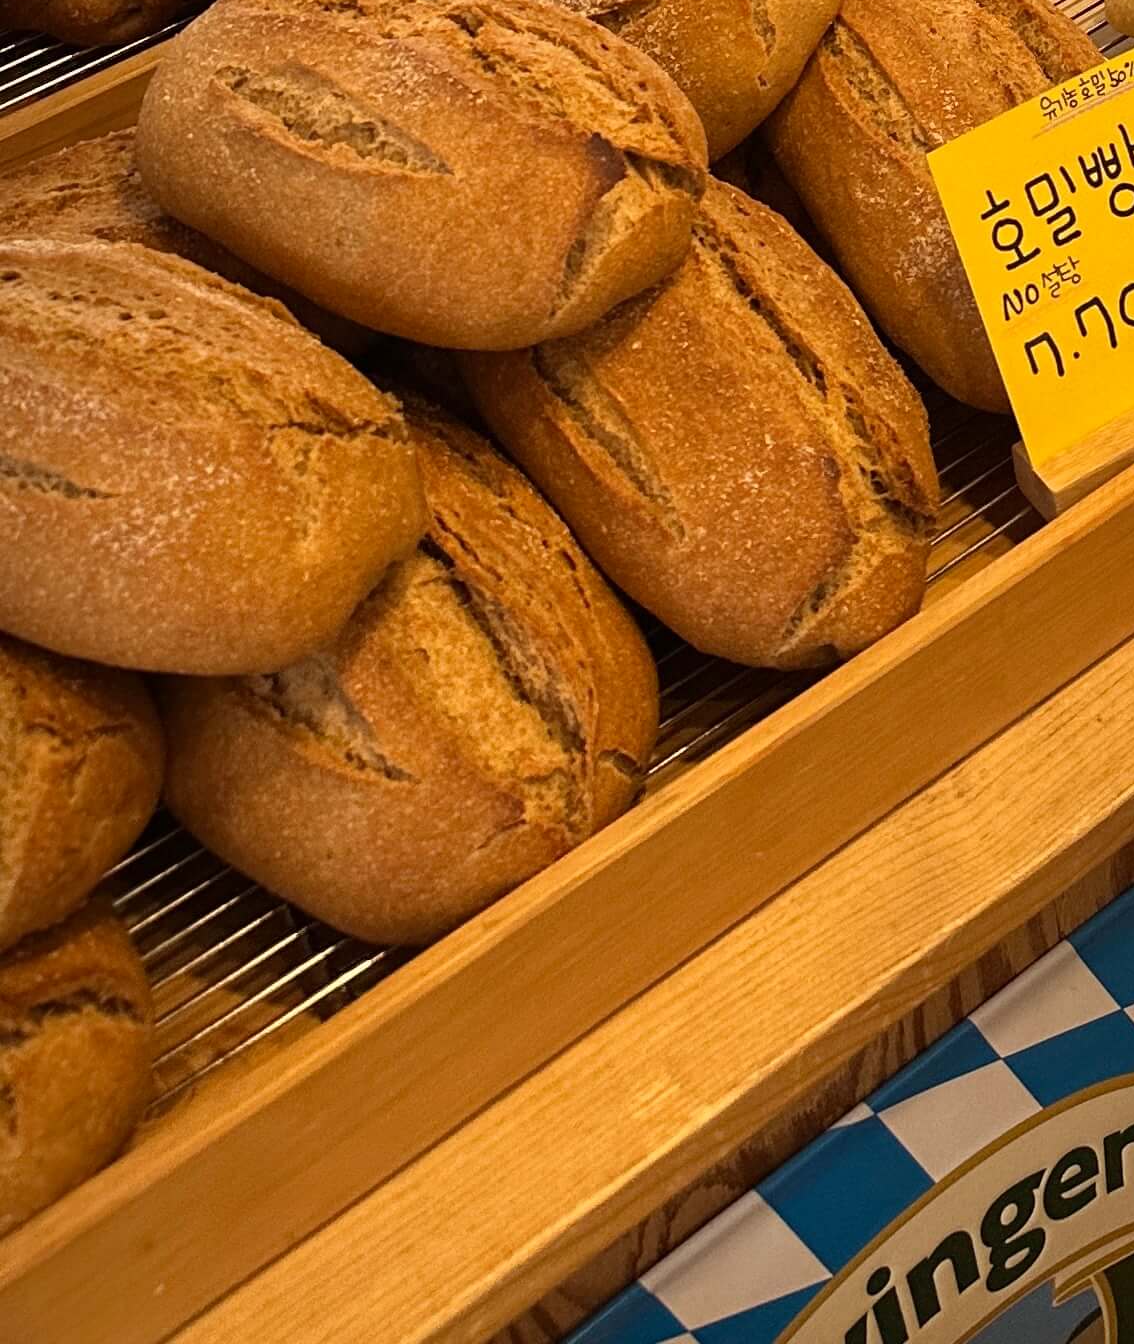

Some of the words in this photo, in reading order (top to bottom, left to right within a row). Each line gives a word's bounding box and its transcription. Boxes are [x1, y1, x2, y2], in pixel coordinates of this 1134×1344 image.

[1040, 88, 1078, 120] 유기농
[1079, 71, 1106, 100] 호밀
[1002, 284, 1039, 321] NO
[1041, 256, 1084, 300] 설탕
